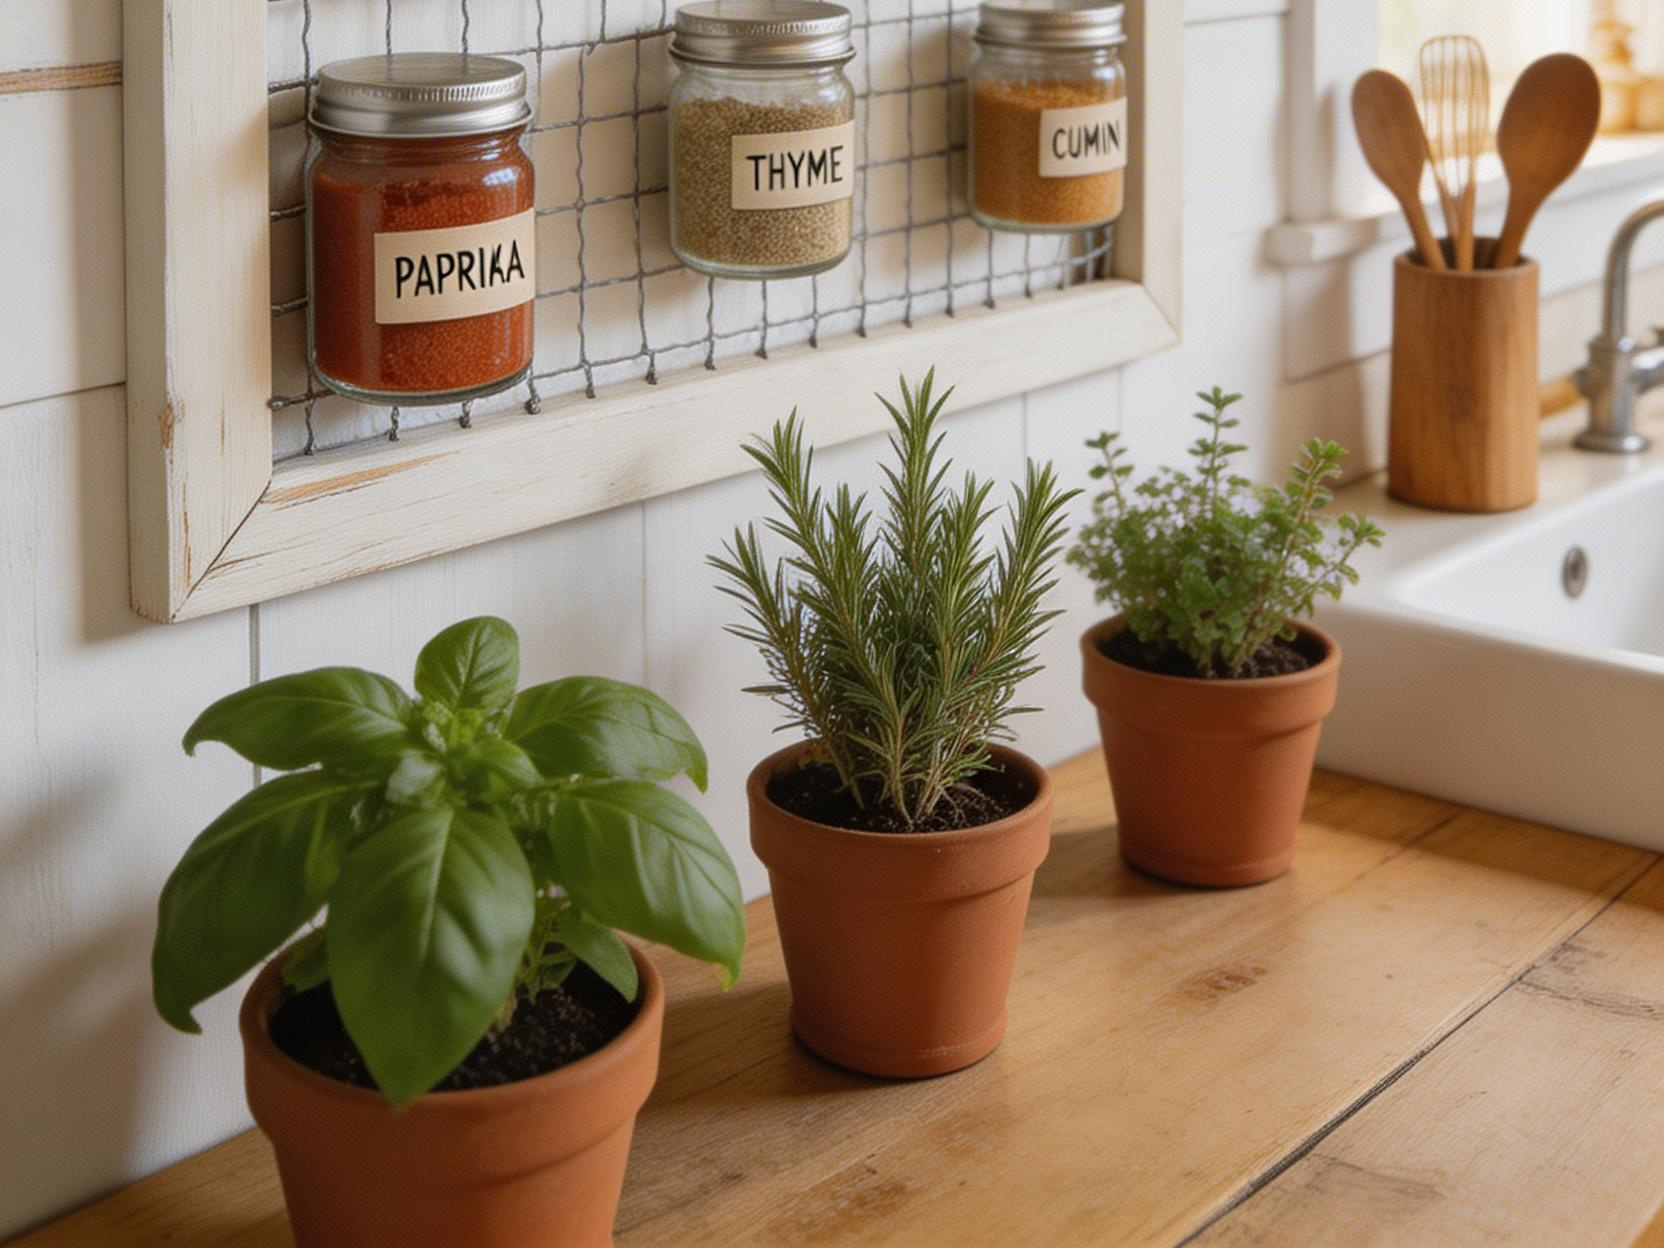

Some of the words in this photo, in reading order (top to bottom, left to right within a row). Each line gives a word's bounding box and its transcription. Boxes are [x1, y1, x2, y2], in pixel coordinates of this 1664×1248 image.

[1053, 120, 1120, 160] CUMIN
[746, 145, 844, 191] THYME
[395, 239, 525, 299] PAPRIKA
